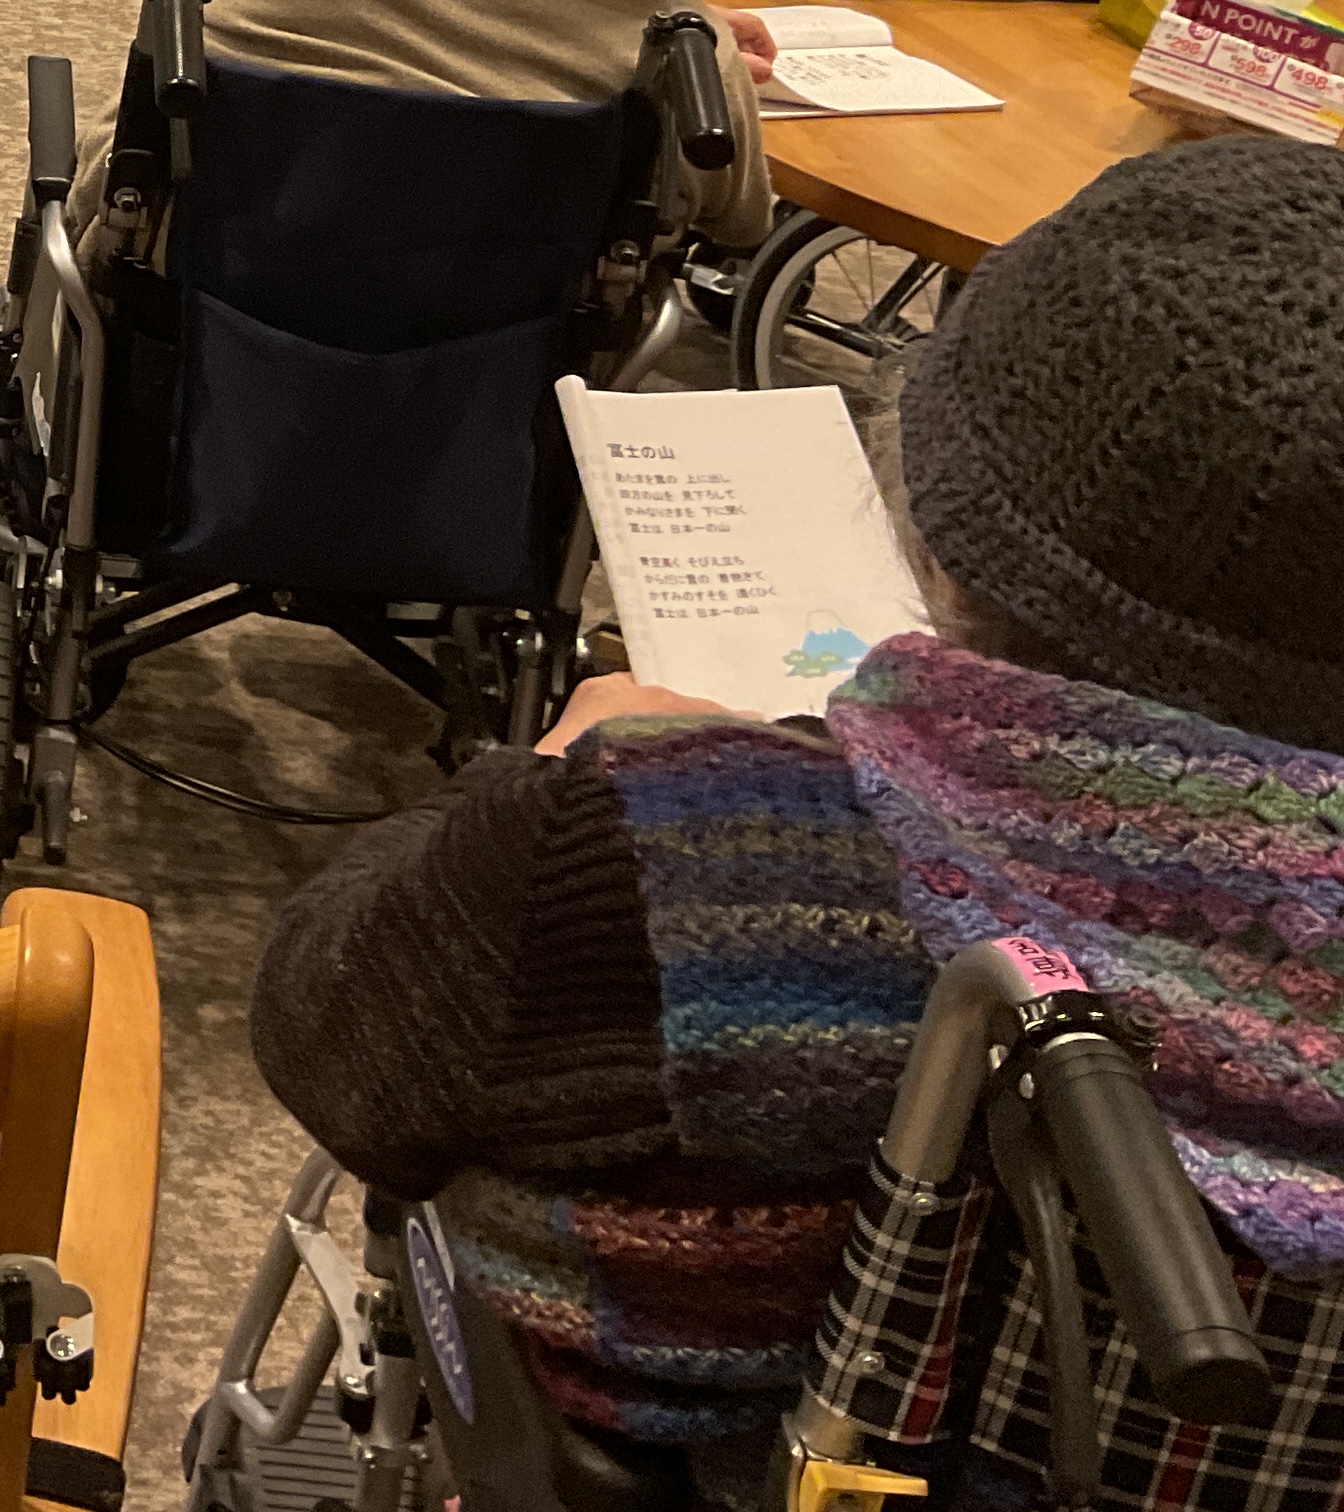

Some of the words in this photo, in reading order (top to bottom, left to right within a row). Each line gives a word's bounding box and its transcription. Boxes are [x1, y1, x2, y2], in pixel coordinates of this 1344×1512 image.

[1224, 7, 1300, 45] POINT
[1168, 35, 1202, 56] 298
[1291, 67, 1329, 91] 498
